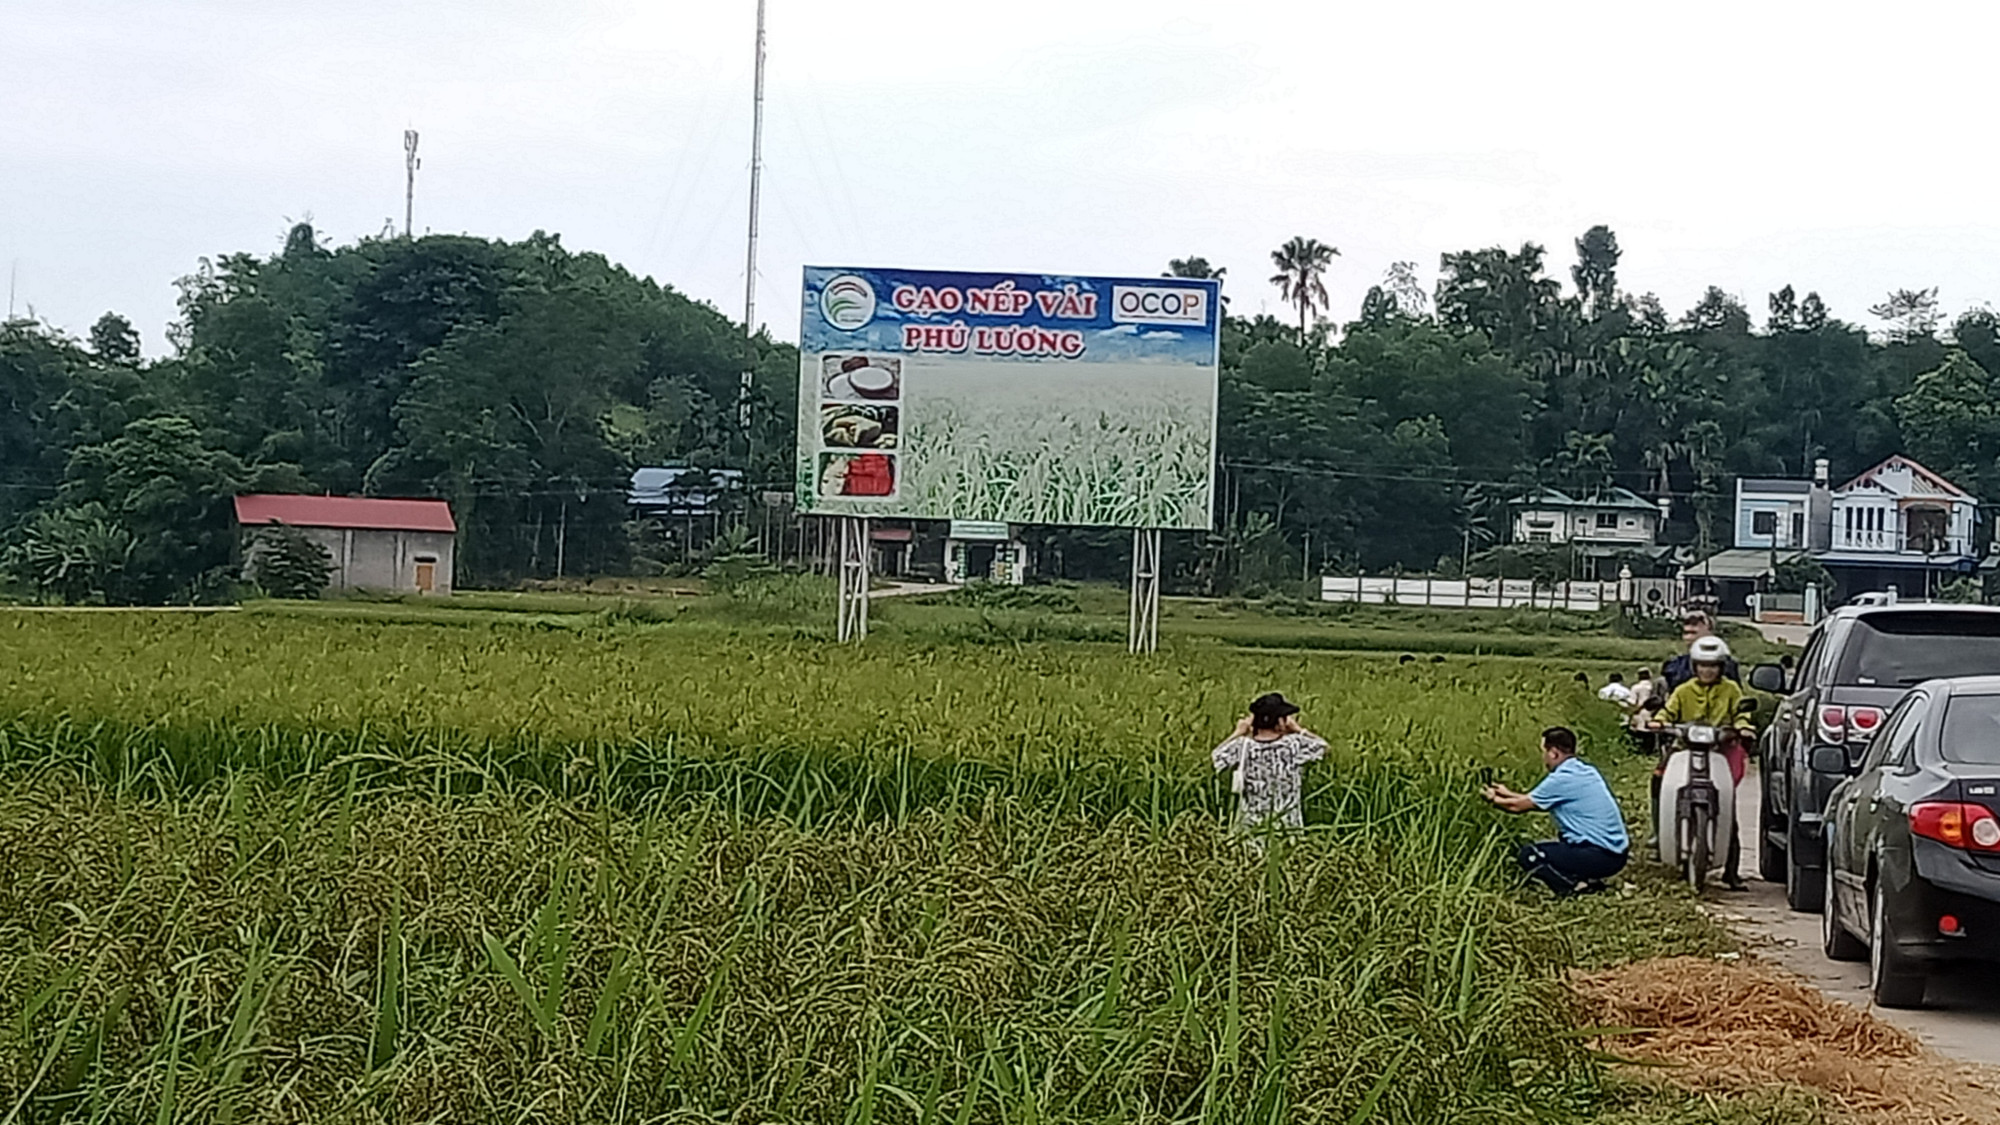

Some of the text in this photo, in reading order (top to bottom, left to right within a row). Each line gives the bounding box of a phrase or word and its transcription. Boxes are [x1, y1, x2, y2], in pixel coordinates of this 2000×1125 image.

[894, 282, 1095, 316] GẠO NẾP VẢI
[1119, 291, 1199, 316] OCOP
[904, 322, 1082, 355] PHÚ LƯƠNG
